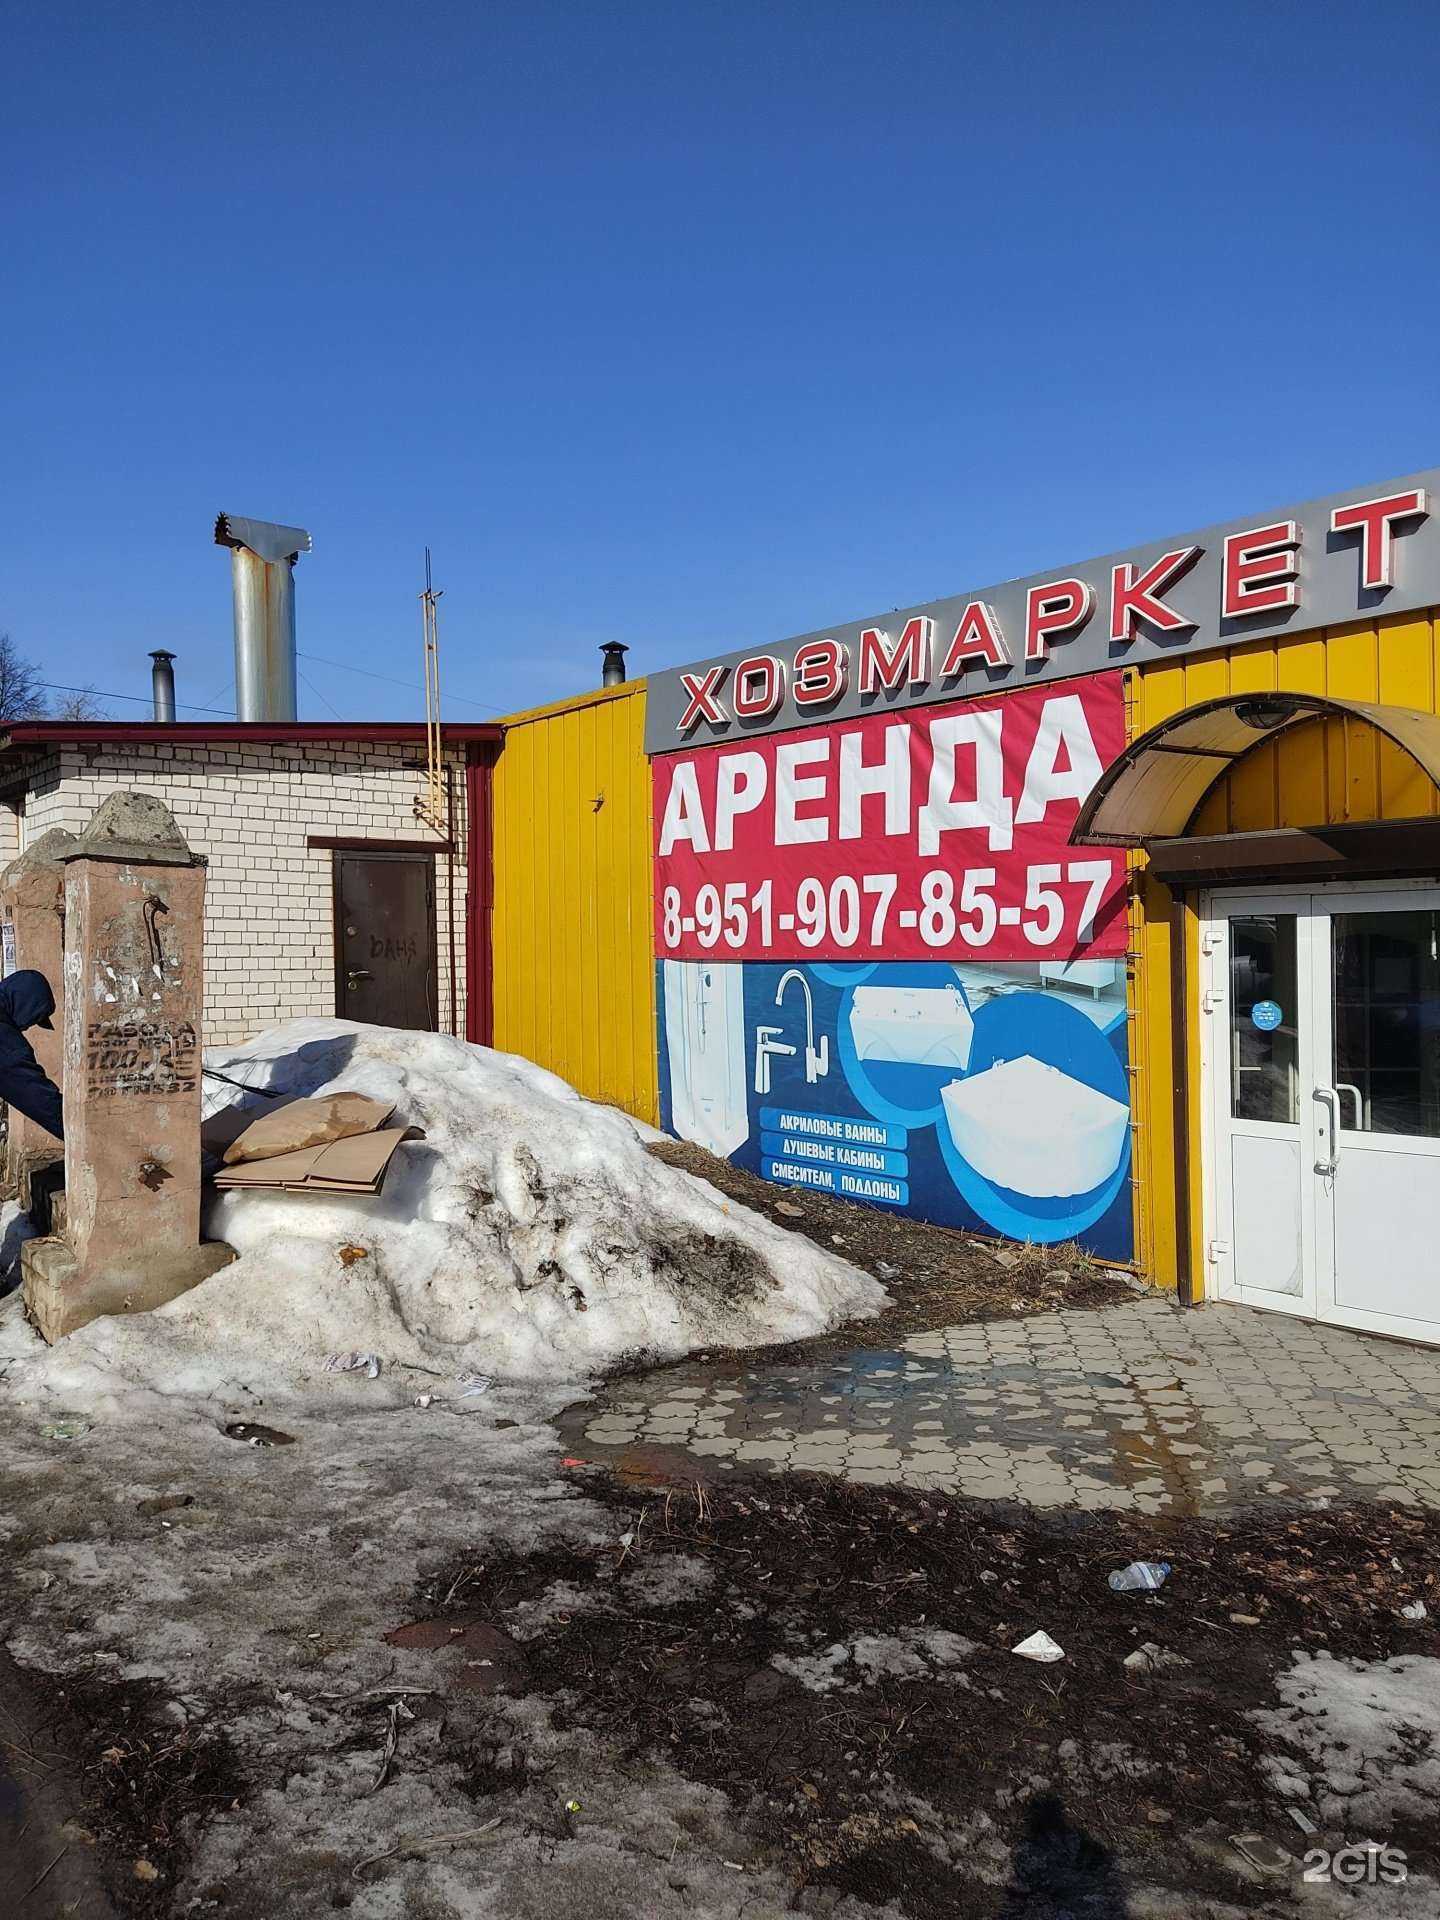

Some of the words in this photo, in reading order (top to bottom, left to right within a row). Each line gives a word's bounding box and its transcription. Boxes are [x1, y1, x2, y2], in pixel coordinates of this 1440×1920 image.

[676, 488, 1426, 731] ХОЗМАРКЕТ
[658, 694, 1104, 857] АРЕНДА
[663, 859, 1112, 949] 8-951-907-85-57
[780, 1114, 843, 1138] АКРИЛОВЫЕ
[845, 1123, 887, 1145] ВАННЫ
[783, 1139, 834, 1162] ДУШЕВЫЕ
[836, 1147, 885, 1170] КАБИНЫ
[772, 1162, 836, 1191] СМЕСИТЕЛИ,
[841, 1175, 900, 1201] ПОДДОНЫ
